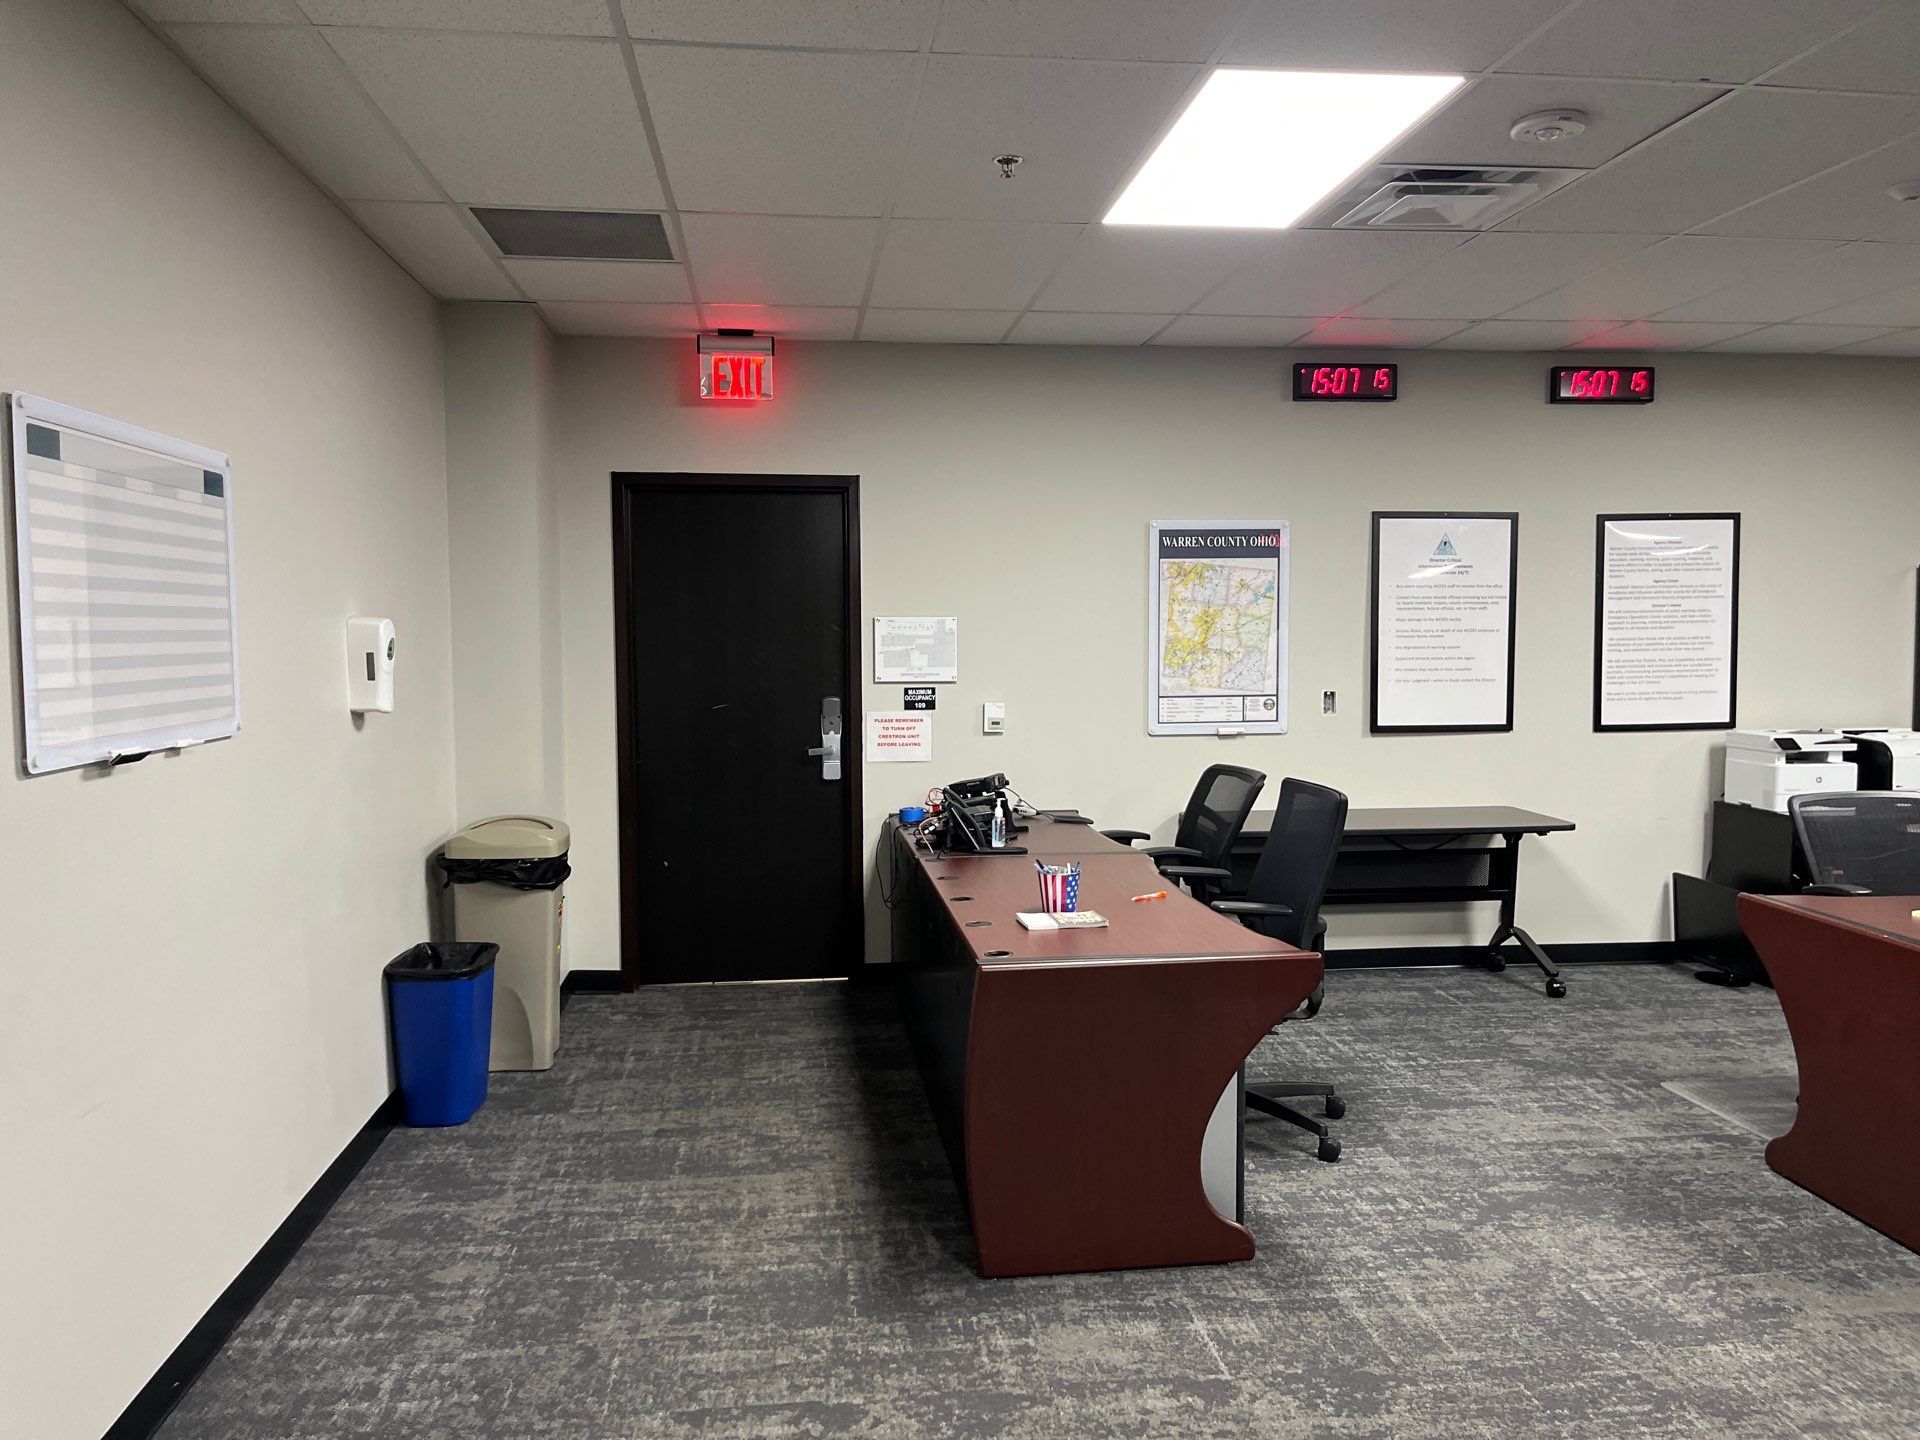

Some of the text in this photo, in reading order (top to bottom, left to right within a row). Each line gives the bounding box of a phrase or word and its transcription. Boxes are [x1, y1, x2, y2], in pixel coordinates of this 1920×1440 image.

[712, 356, 765, 398] EXIT
[1311, 367, 1362, 395] 15:07
[1162, 536, 1276, 547] WARREN COUNTY OHIO
